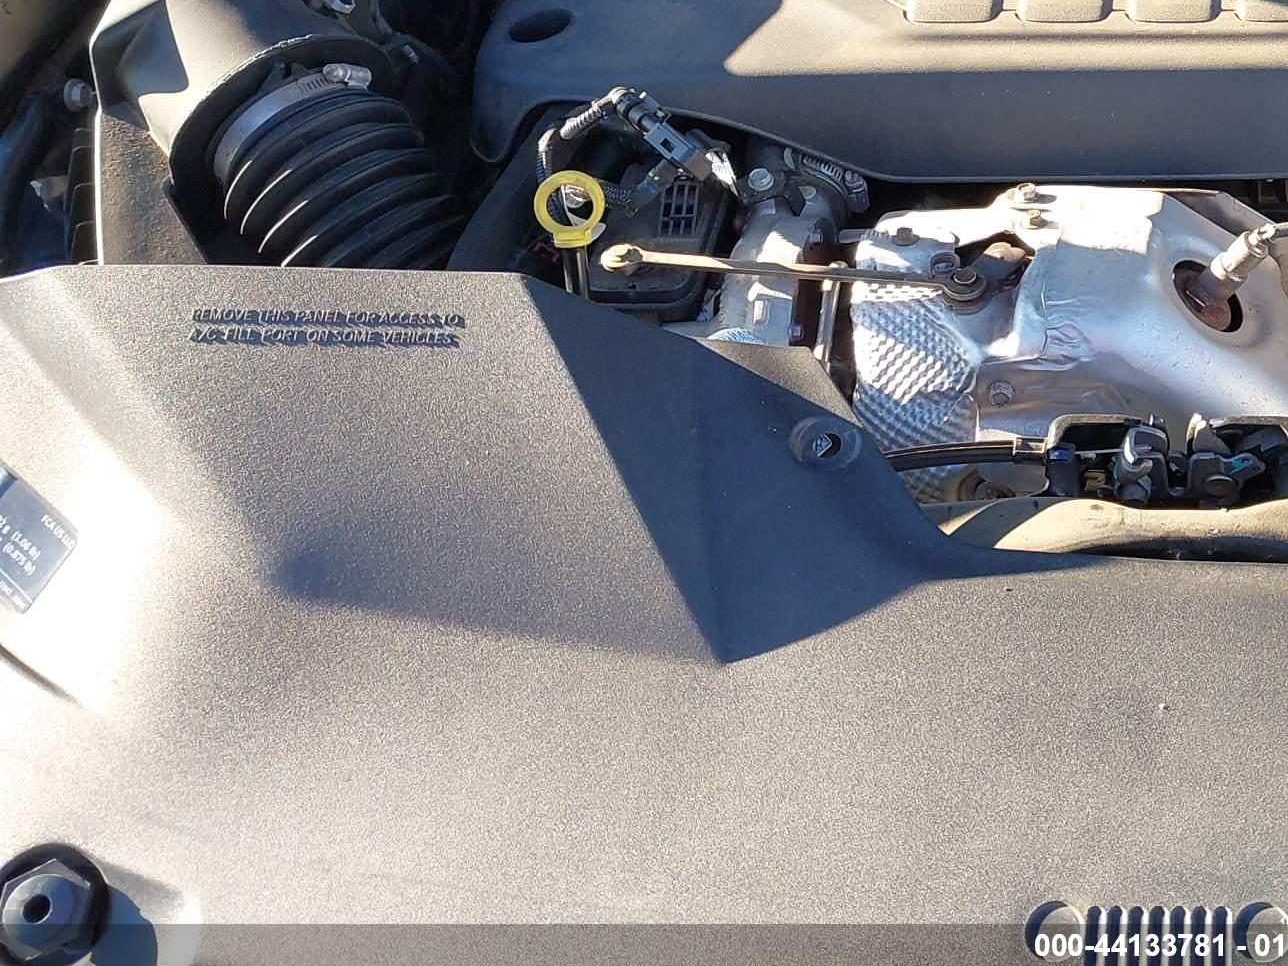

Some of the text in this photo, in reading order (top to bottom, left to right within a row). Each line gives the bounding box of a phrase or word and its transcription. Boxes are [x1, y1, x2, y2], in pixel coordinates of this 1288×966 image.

[191, 307, 462, 327] REMOVE THIS PANEL FOR ACCESS TO
[187, 326, 454, 346] A/C FILL PORT ON SOME VEHICLES
[40, 513, 56, 531] FCA
[53, 525, 65, 539] US
